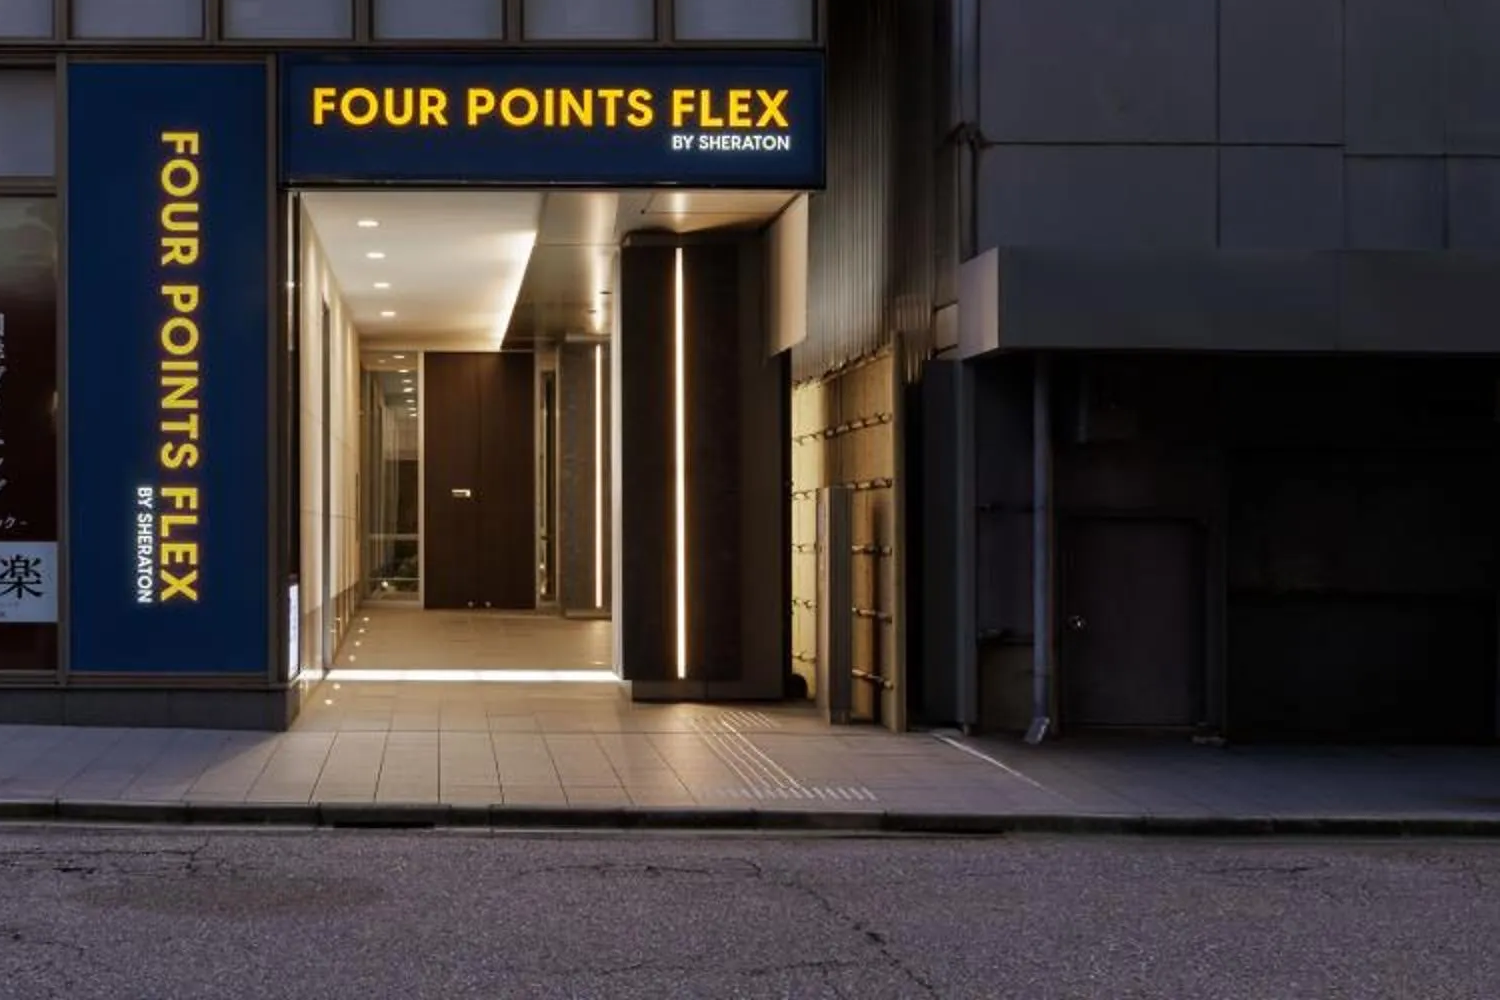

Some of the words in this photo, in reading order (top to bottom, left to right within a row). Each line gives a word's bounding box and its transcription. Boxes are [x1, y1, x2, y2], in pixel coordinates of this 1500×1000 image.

[313, 87, 449, 127] FOUR
[467, 87, 654, 128] POINTS
[671, 89, 789, 128] FLEX
[672, 134, 693, 151] BY
[698, 134, 791, 151] SHERATON
[160, 132, 199, 265] FOUR
[160, 284, 199, 469] POINTS
[137, 486, 154, 507] BY
[137, 512, 154, 603] SHERATON
[160, 486, 198, 600] FLEX
